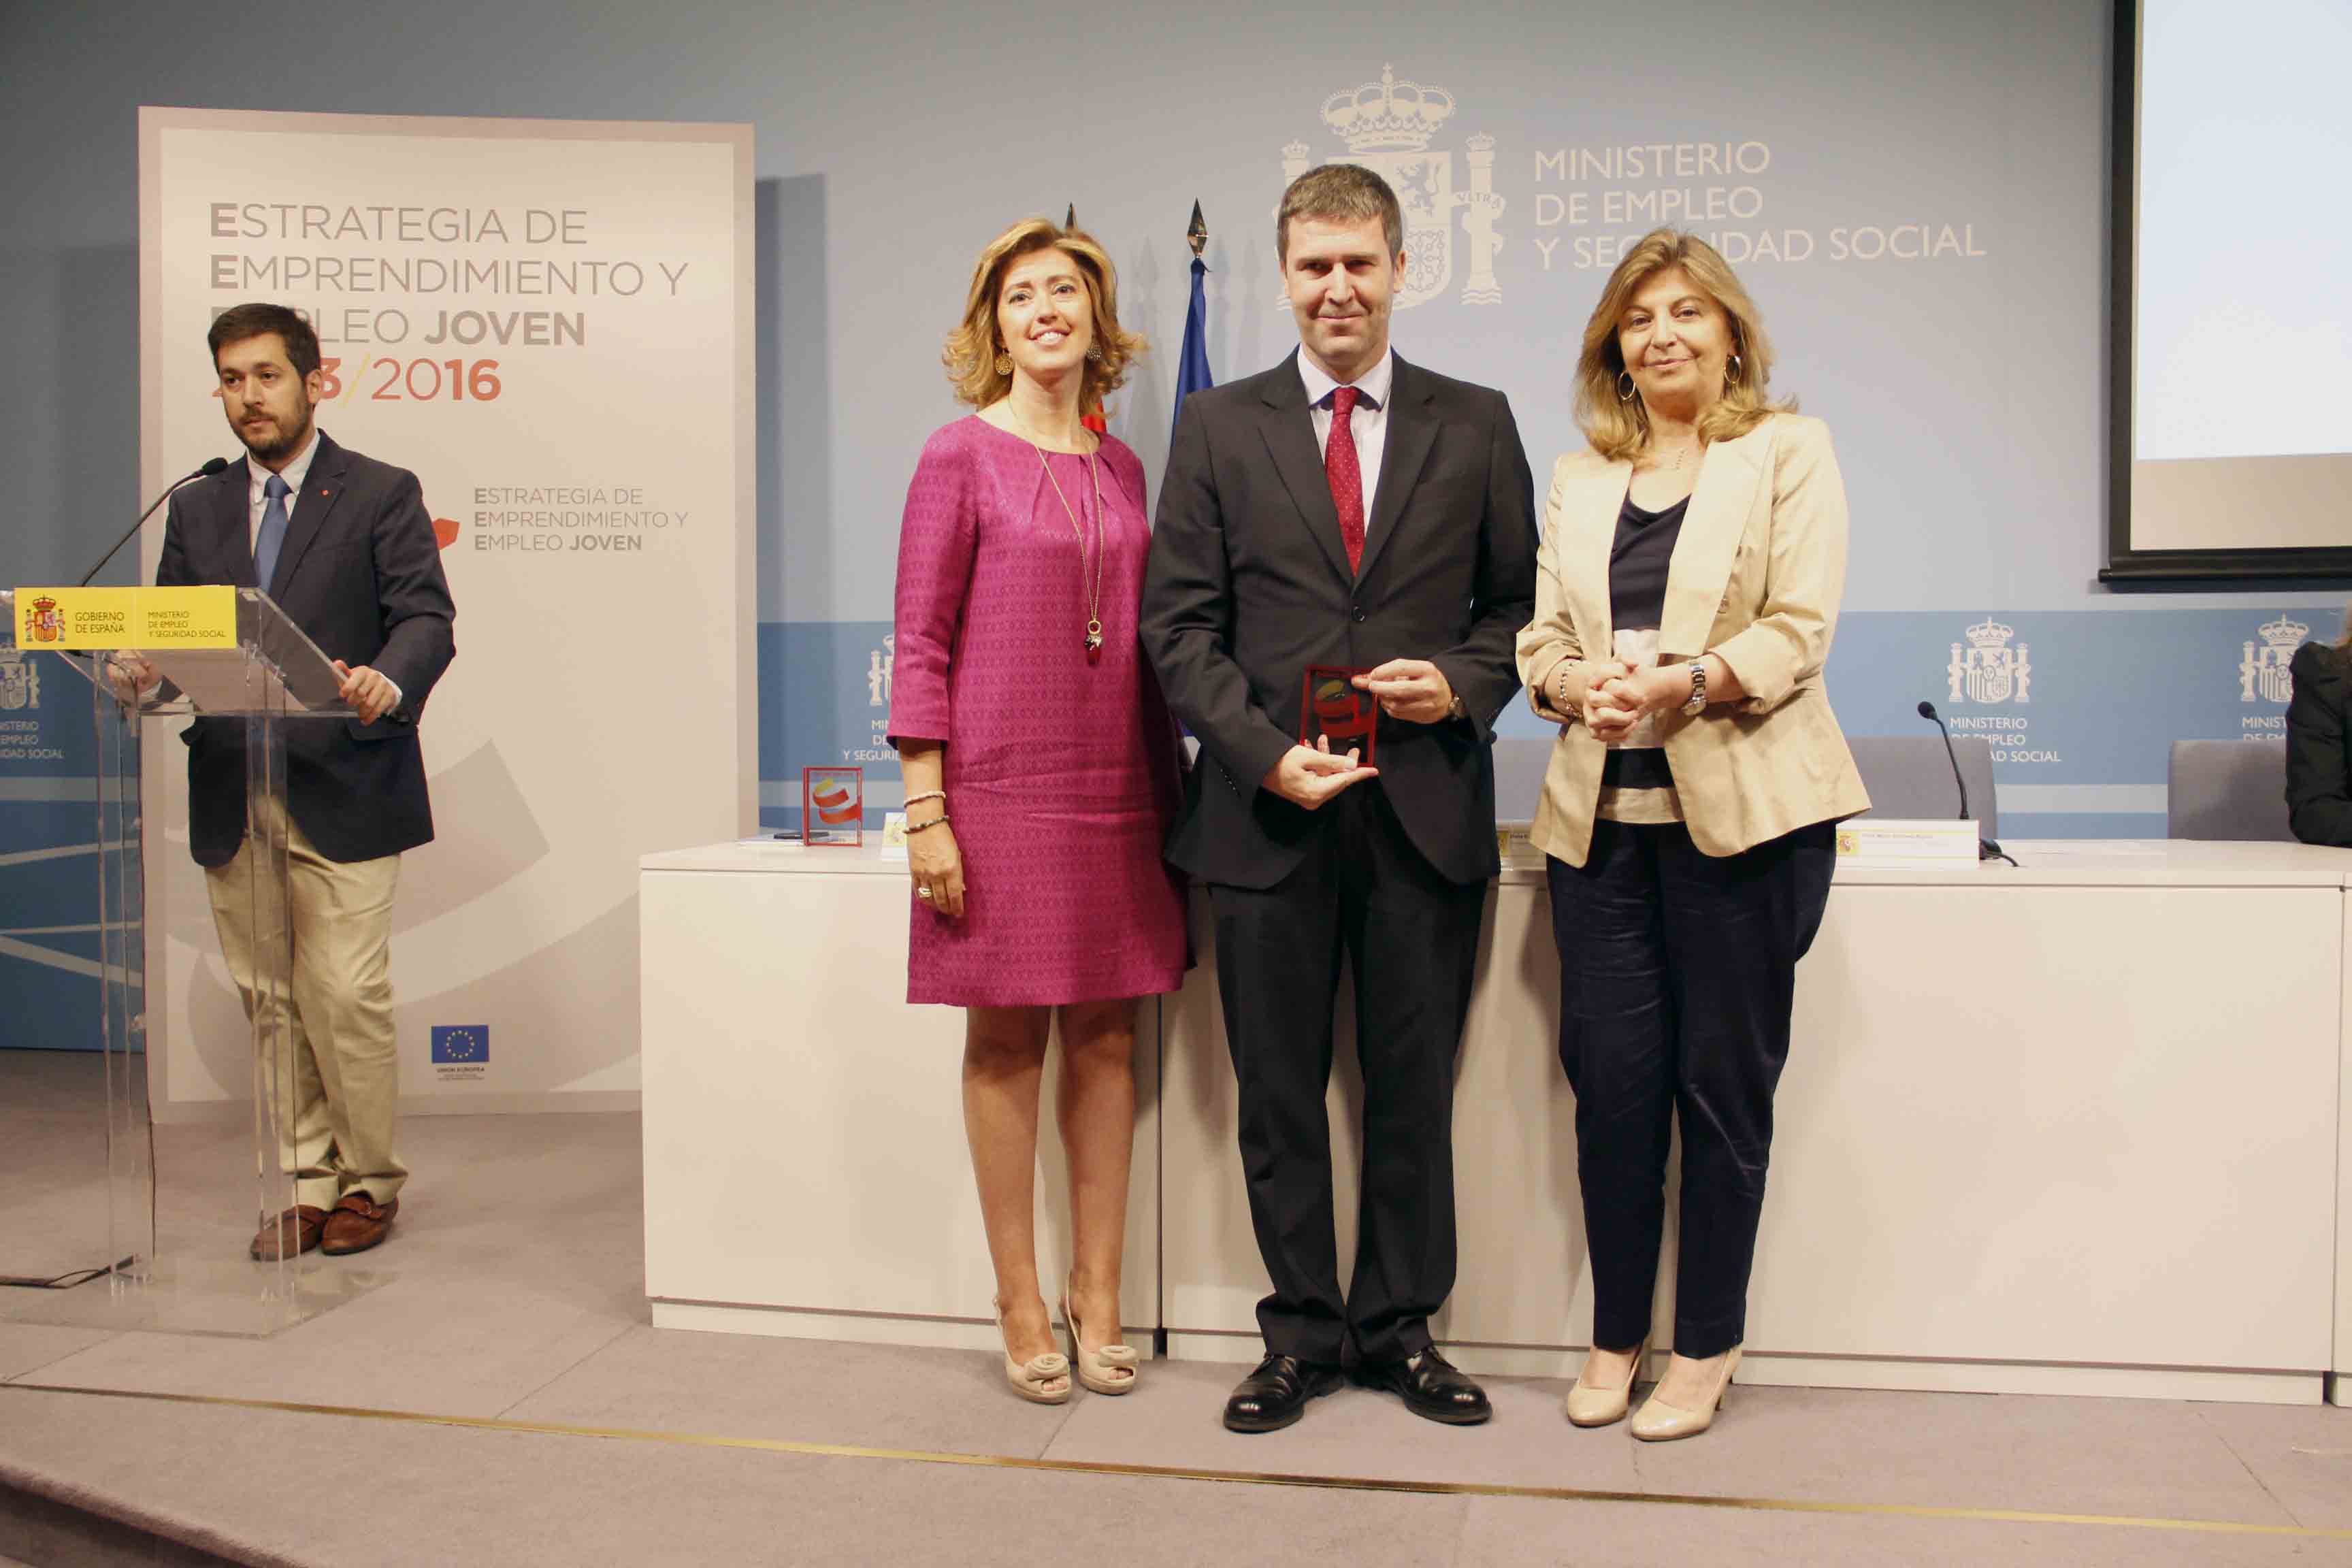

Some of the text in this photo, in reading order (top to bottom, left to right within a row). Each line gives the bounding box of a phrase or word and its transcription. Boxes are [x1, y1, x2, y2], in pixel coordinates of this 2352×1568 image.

[1534, 142, 1771, 182] MINISTERIO
[1535, 186, 1763, 226] DE EMPLEO
[210, 203, 587, 244] ESTRATEGIA DE
[1533, 224, 1987, 270] Y SEIDAD SOCIAL
[211, 255, 689, 296] EMPRENDIMIENTO Y
[424, 310, 585, 346] JOVEN
[474, 487, 643, 505] ESTRATEGIA DE
[474, 511, 689, 528] EMPRENDIMIENTO Y
[474, 534, 642, 551] EMPLEO JOVEN
[75, 611, 125, 621] GOBIERNO
[147, 610, 190, 619] MINISTERIO
[76, 621, 126, 634] DE ESPAÑA
[148, 620, 189, 628] DE EMPLEO
[156, 630, 197, 638] SEGURIDAD
[199, 630, 226, 638] SOCIAL
[1950, 717, 2027, 730] MINISTERIO
[29, 749, 66, 760] SOCIAL
[844, 750, 851, 762] Y
[2010, 751, 2063, 762] SOCIAL
